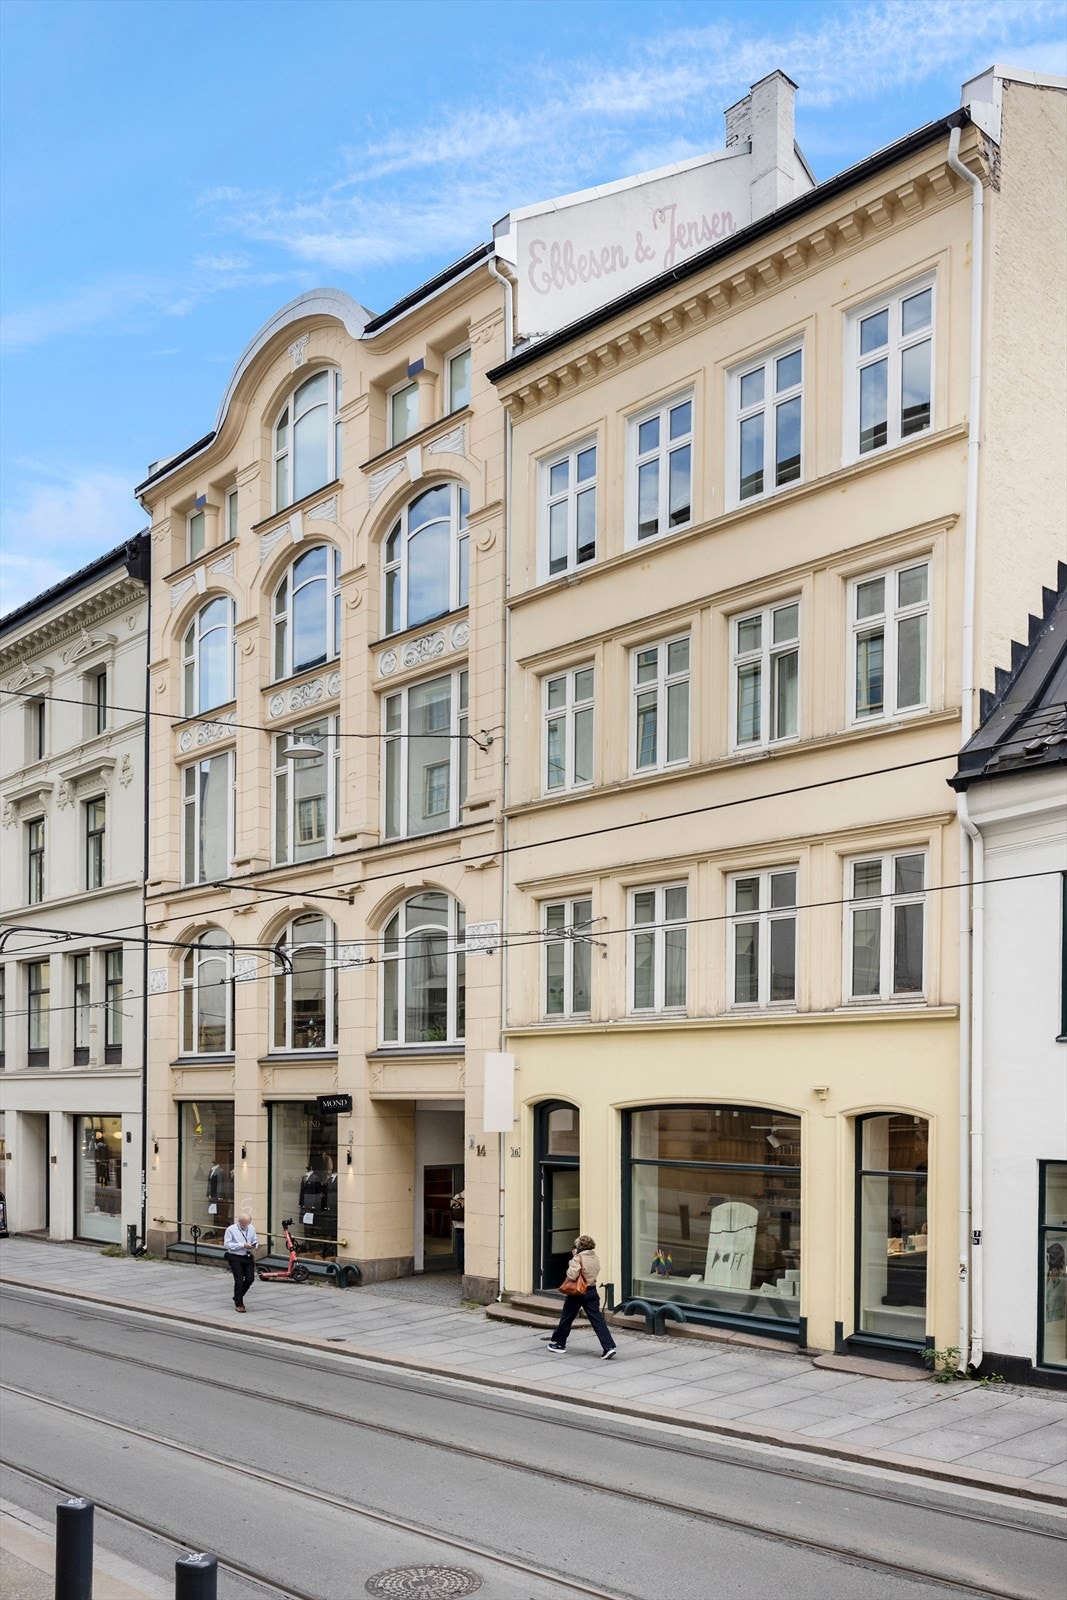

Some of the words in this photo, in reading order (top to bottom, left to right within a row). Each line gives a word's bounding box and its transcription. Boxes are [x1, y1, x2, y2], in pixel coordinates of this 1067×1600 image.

[635, 231, 656, 264] &
[653, 203, 737, 269] Jensen
[322, 1099, 348, 1107] MOND
[476, 1144, 487, 1157] 14
[511, 1148, 520, 1157] 16
